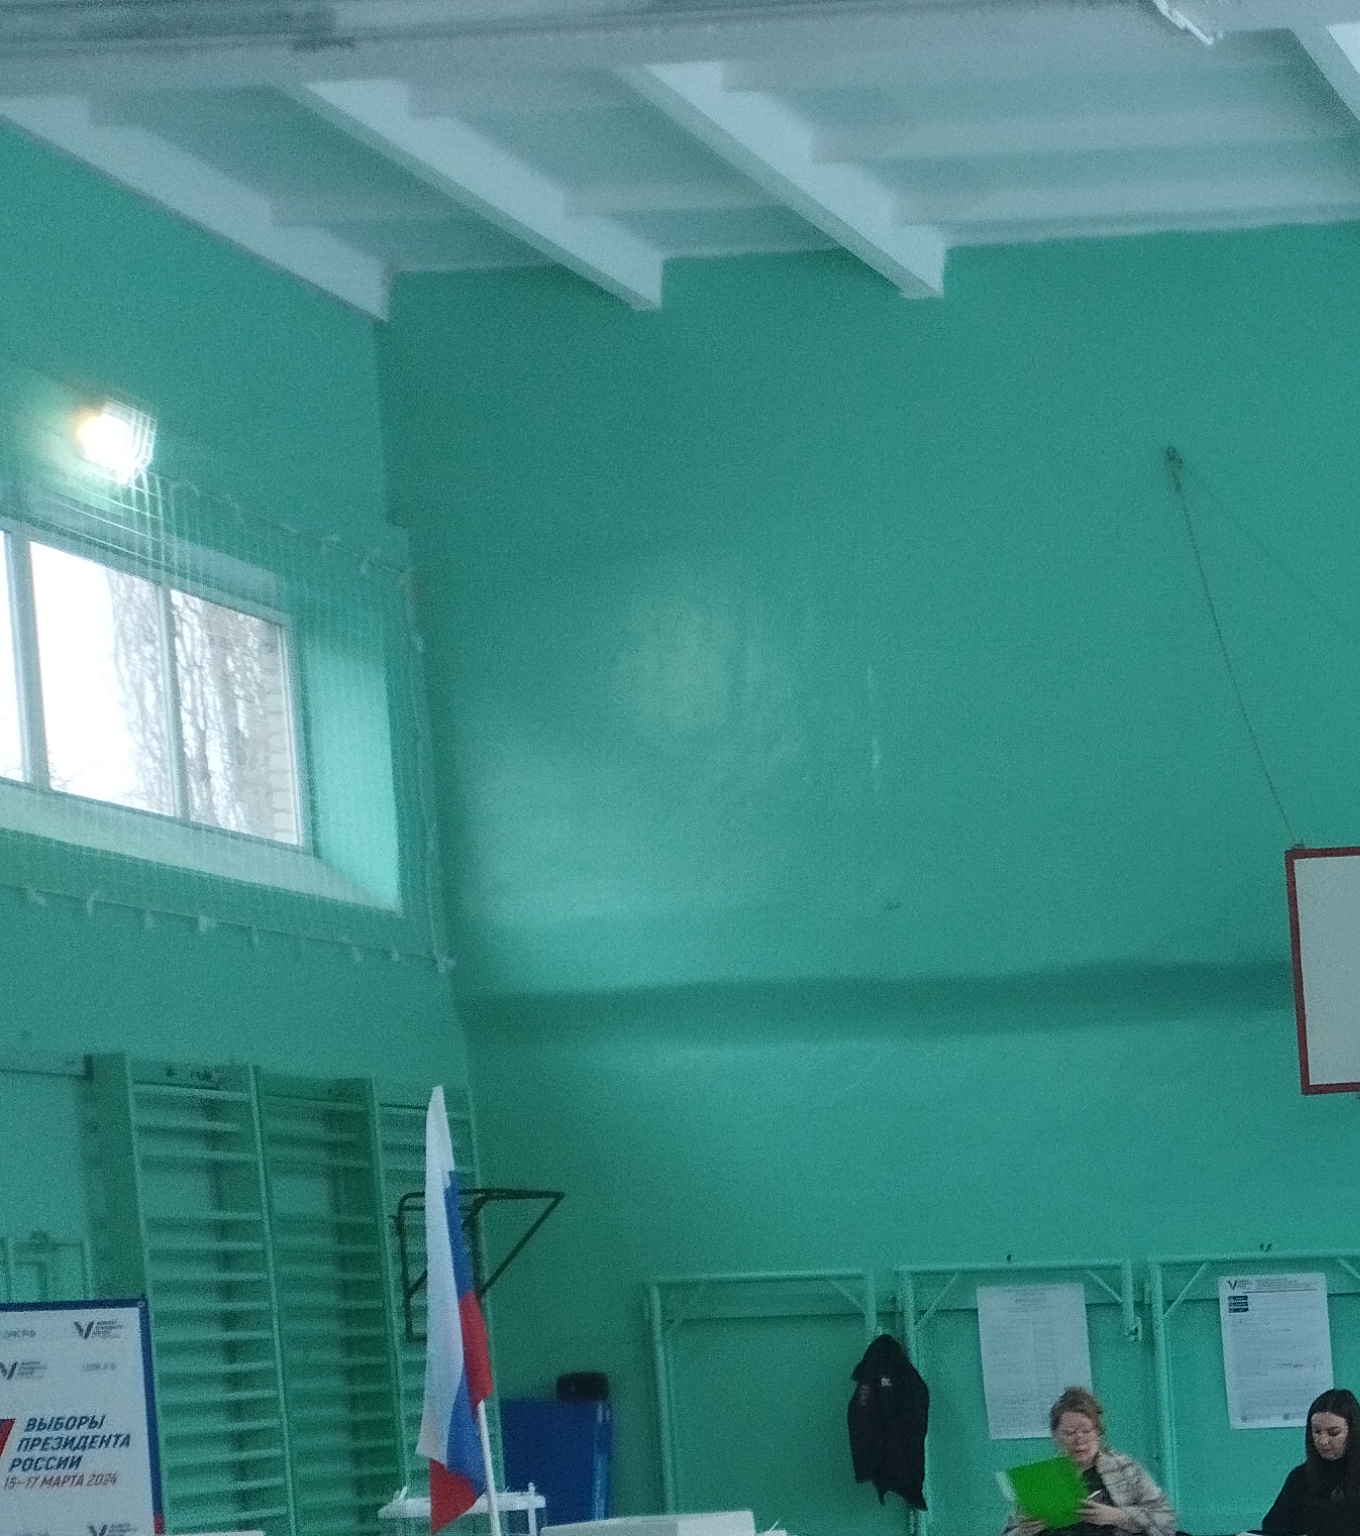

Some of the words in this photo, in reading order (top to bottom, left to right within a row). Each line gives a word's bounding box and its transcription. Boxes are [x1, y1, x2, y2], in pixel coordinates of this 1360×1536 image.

[24, 1413, 107, 1433] ВЫБОРЫ
[17, 1433, 131, 1453] ПРЕЗИДЕНТА
[8, 1454, 84, 1473] РОССИИ
[40, 1473, 85, 1489] МАРТА
